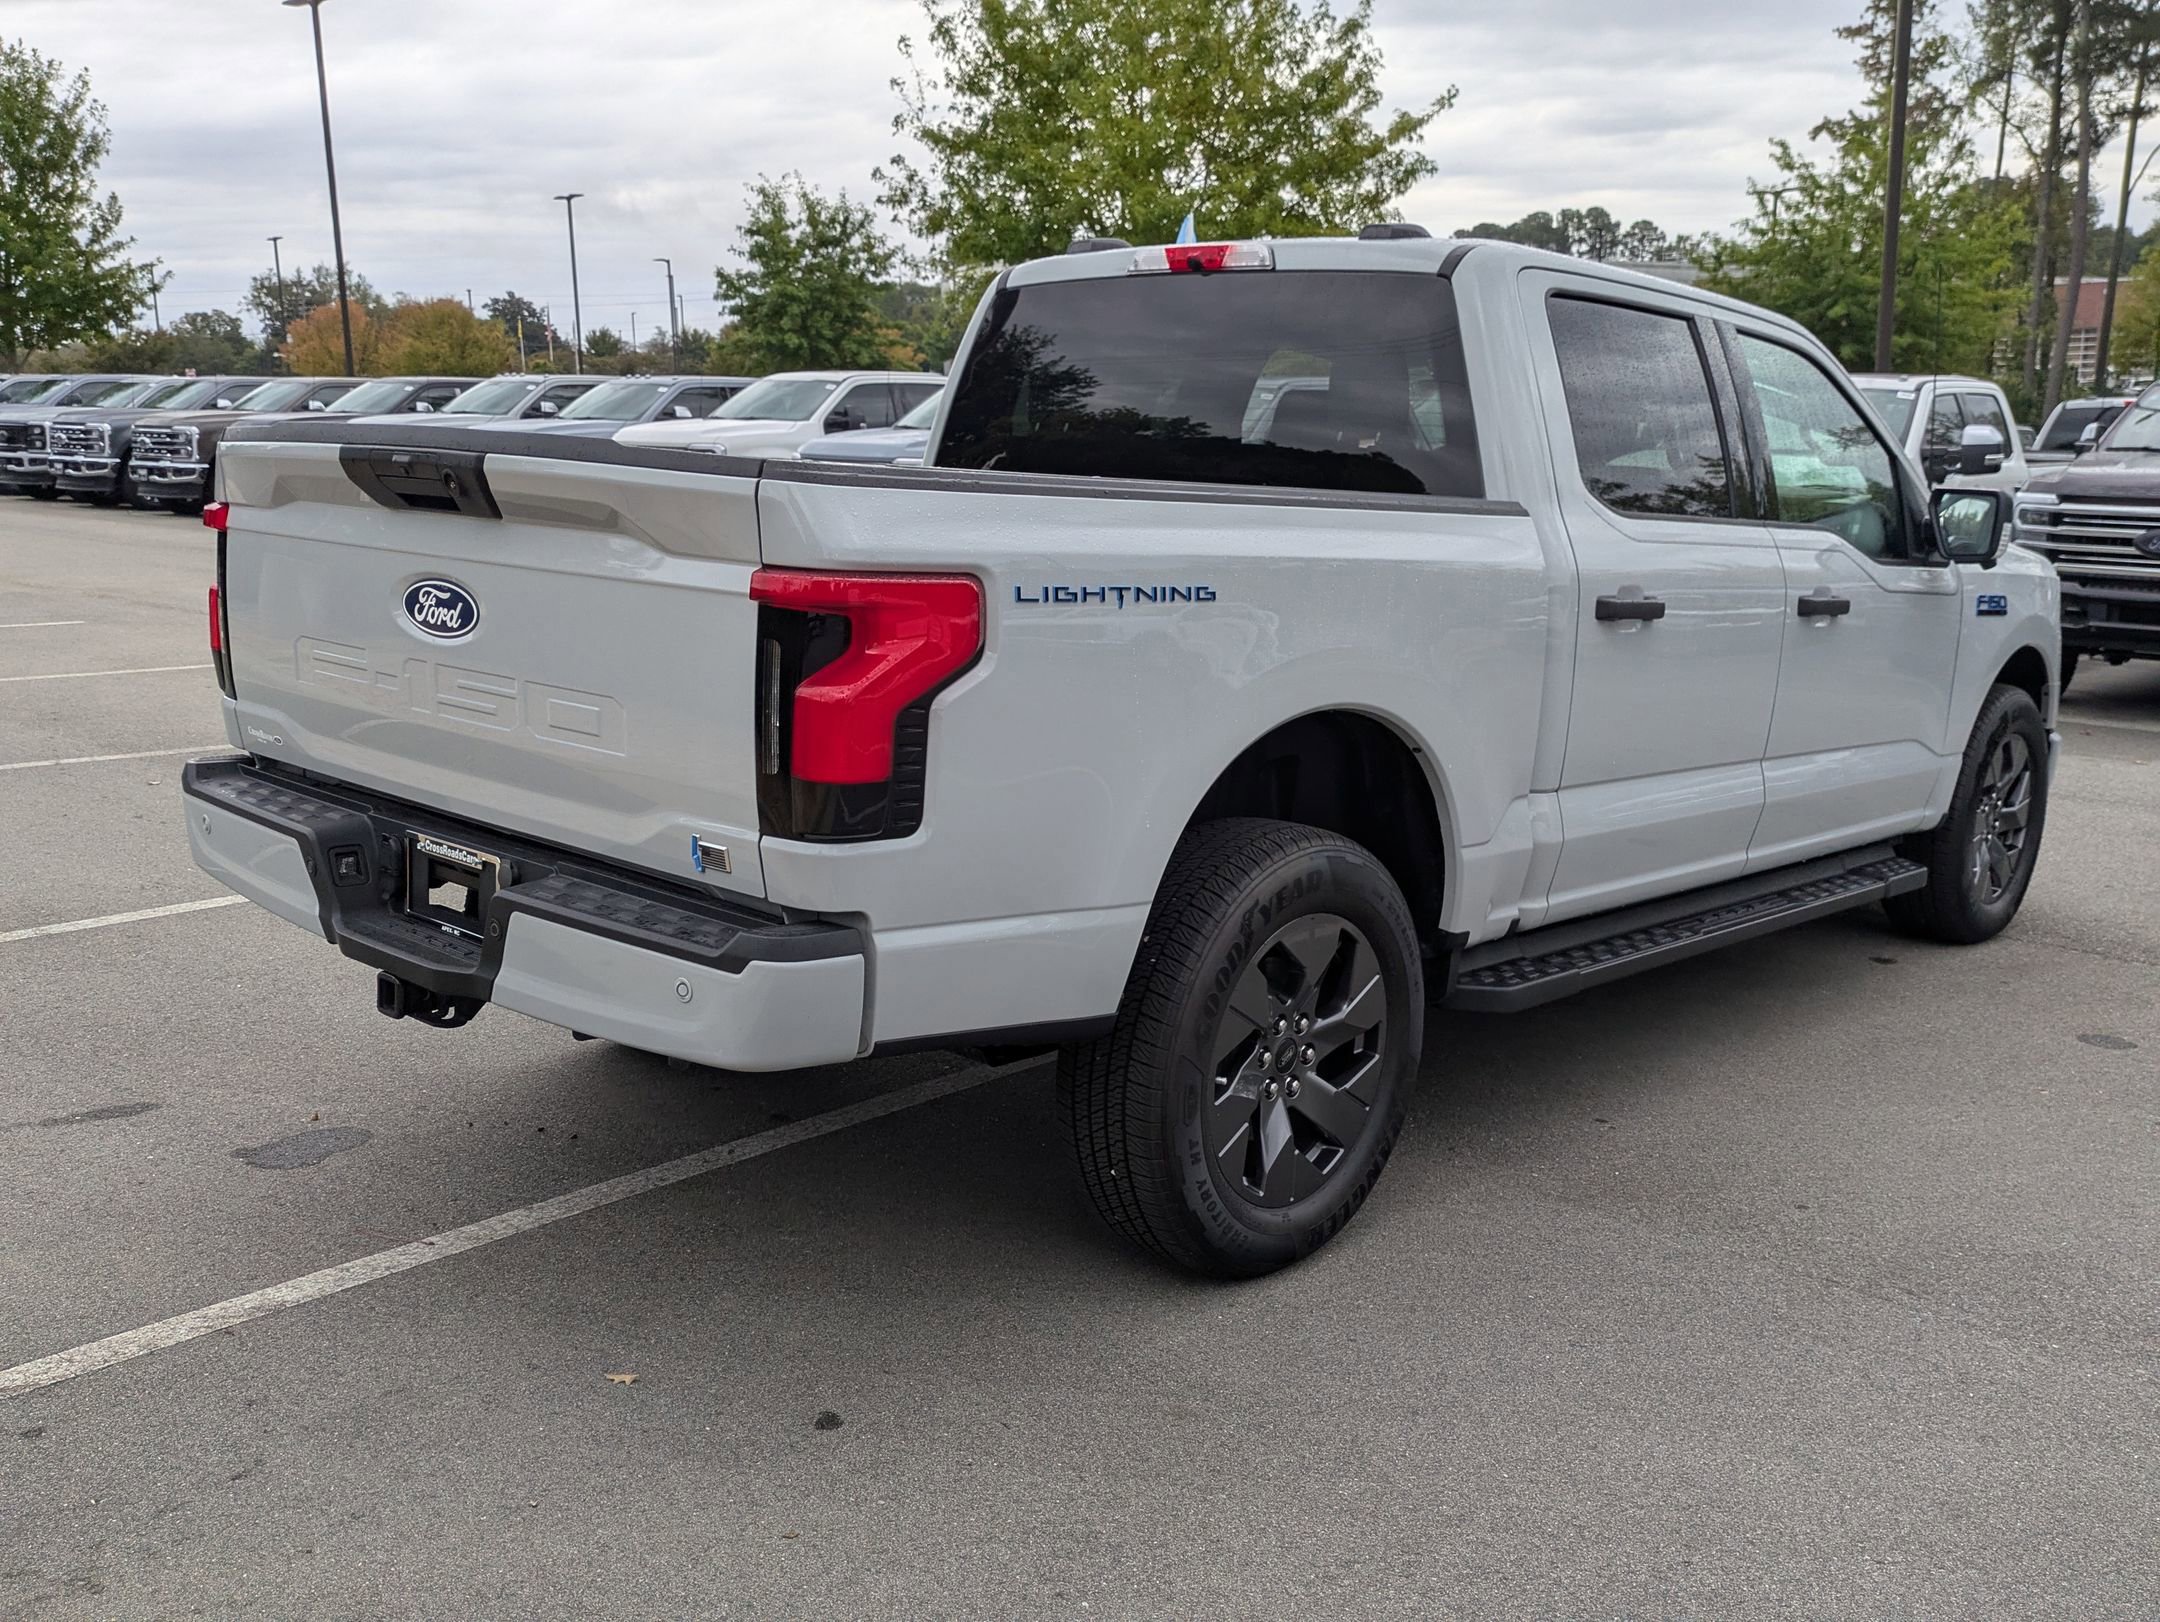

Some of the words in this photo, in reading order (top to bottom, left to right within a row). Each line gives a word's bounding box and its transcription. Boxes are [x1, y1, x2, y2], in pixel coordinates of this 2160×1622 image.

[414, 587, 463, 629] Ford
[1014, 586, 1216, 610] LIGHTNING
[295, 636, 626, 757] F-150
[1196, 869, 1323, 1046] GOODYEAR
[1189, 1139, 1202, 1166] HT
[1308, 1108, 1405, 1247] ANGLER
[1196, 1179, 1256, 1250] ERRITORY
